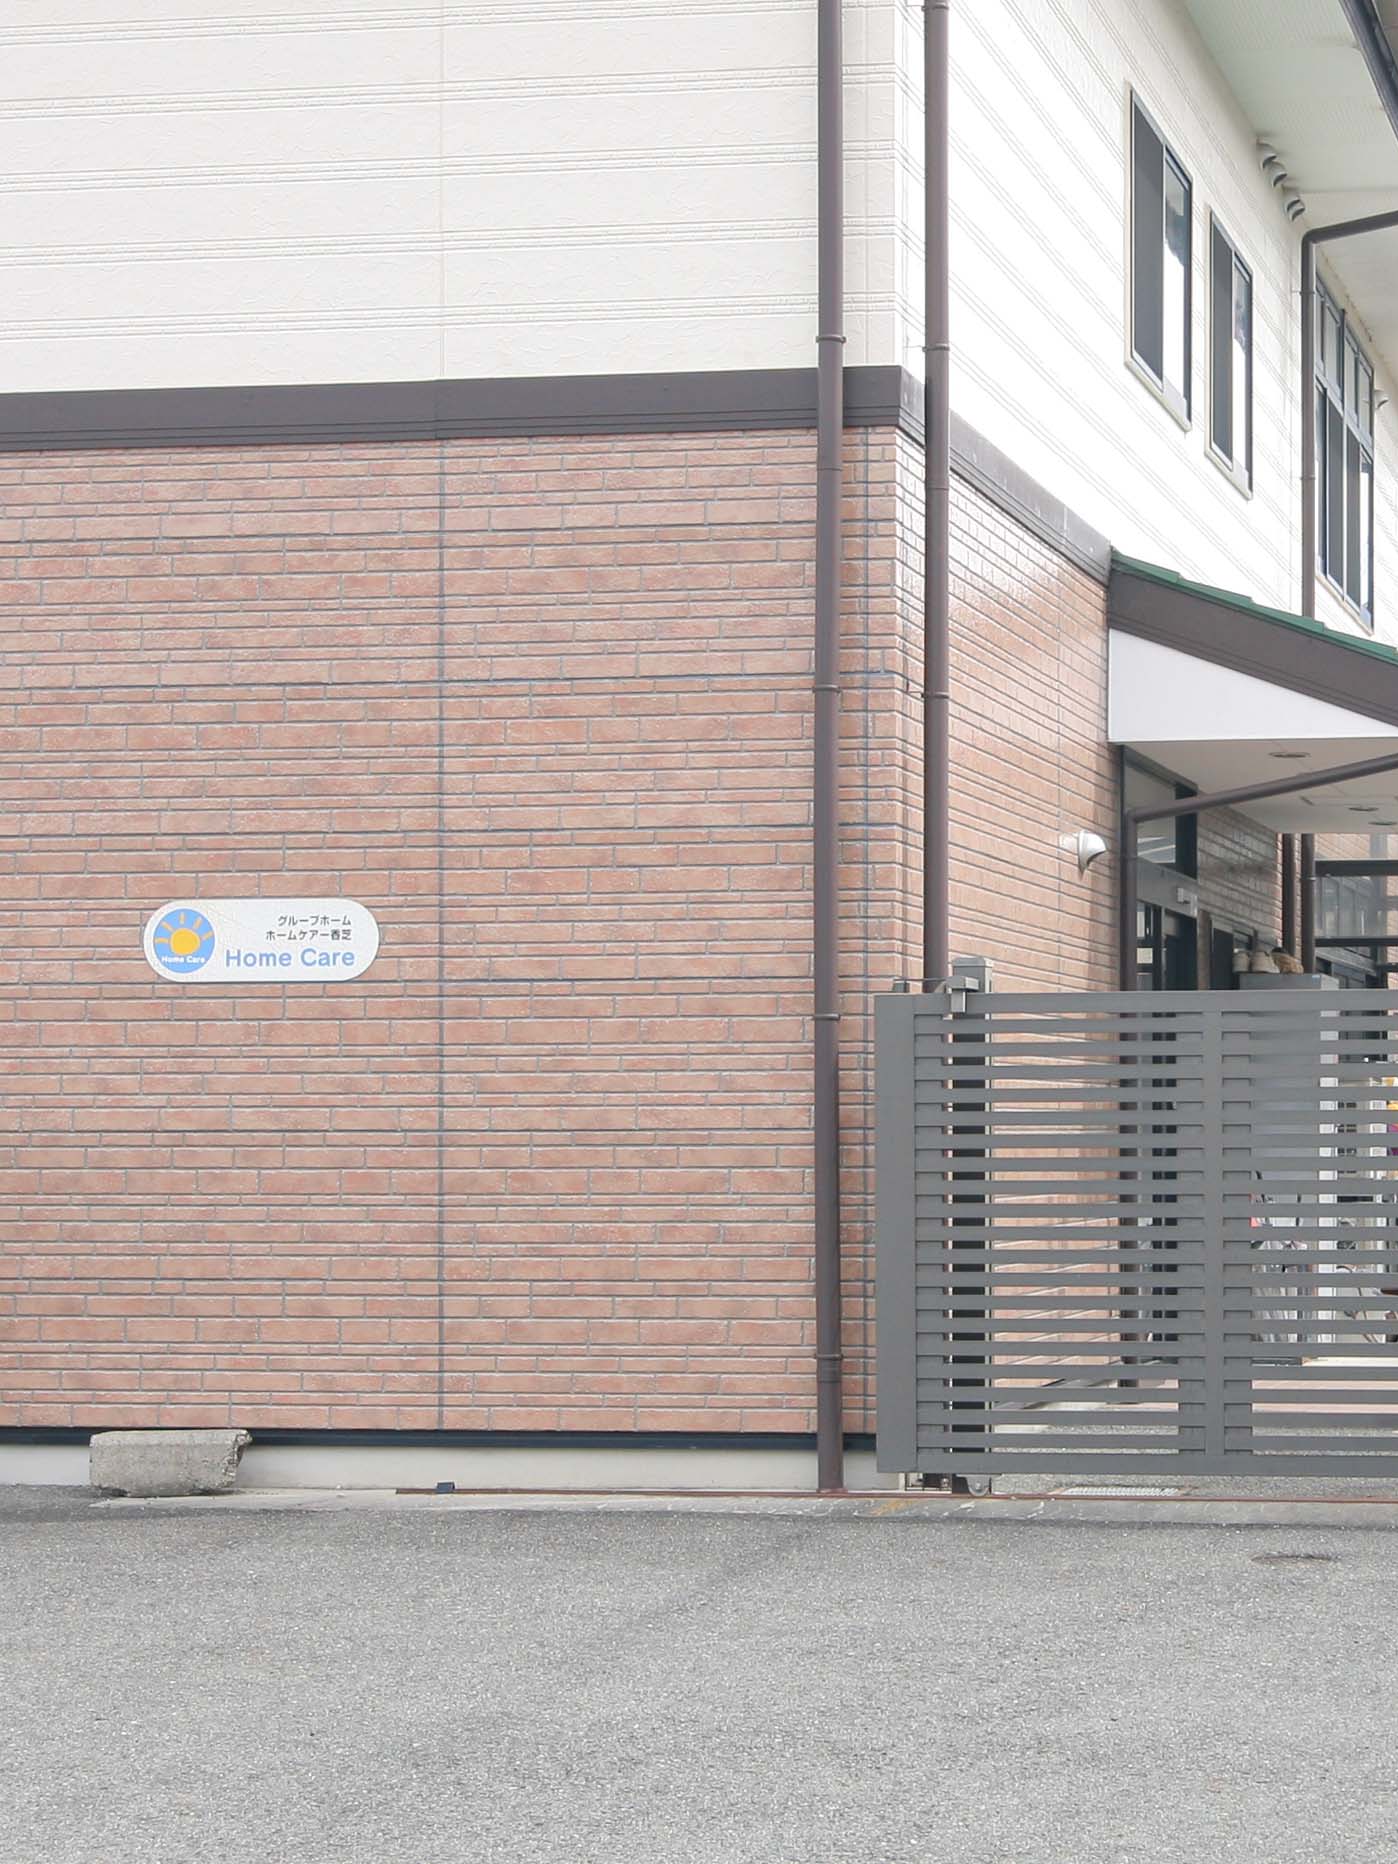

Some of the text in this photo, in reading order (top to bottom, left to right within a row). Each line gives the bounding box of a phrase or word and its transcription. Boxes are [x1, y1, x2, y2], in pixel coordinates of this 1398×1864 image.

[278, 915, 352, 927] グループホーム
[226, 948, 355, 968] Home Care
